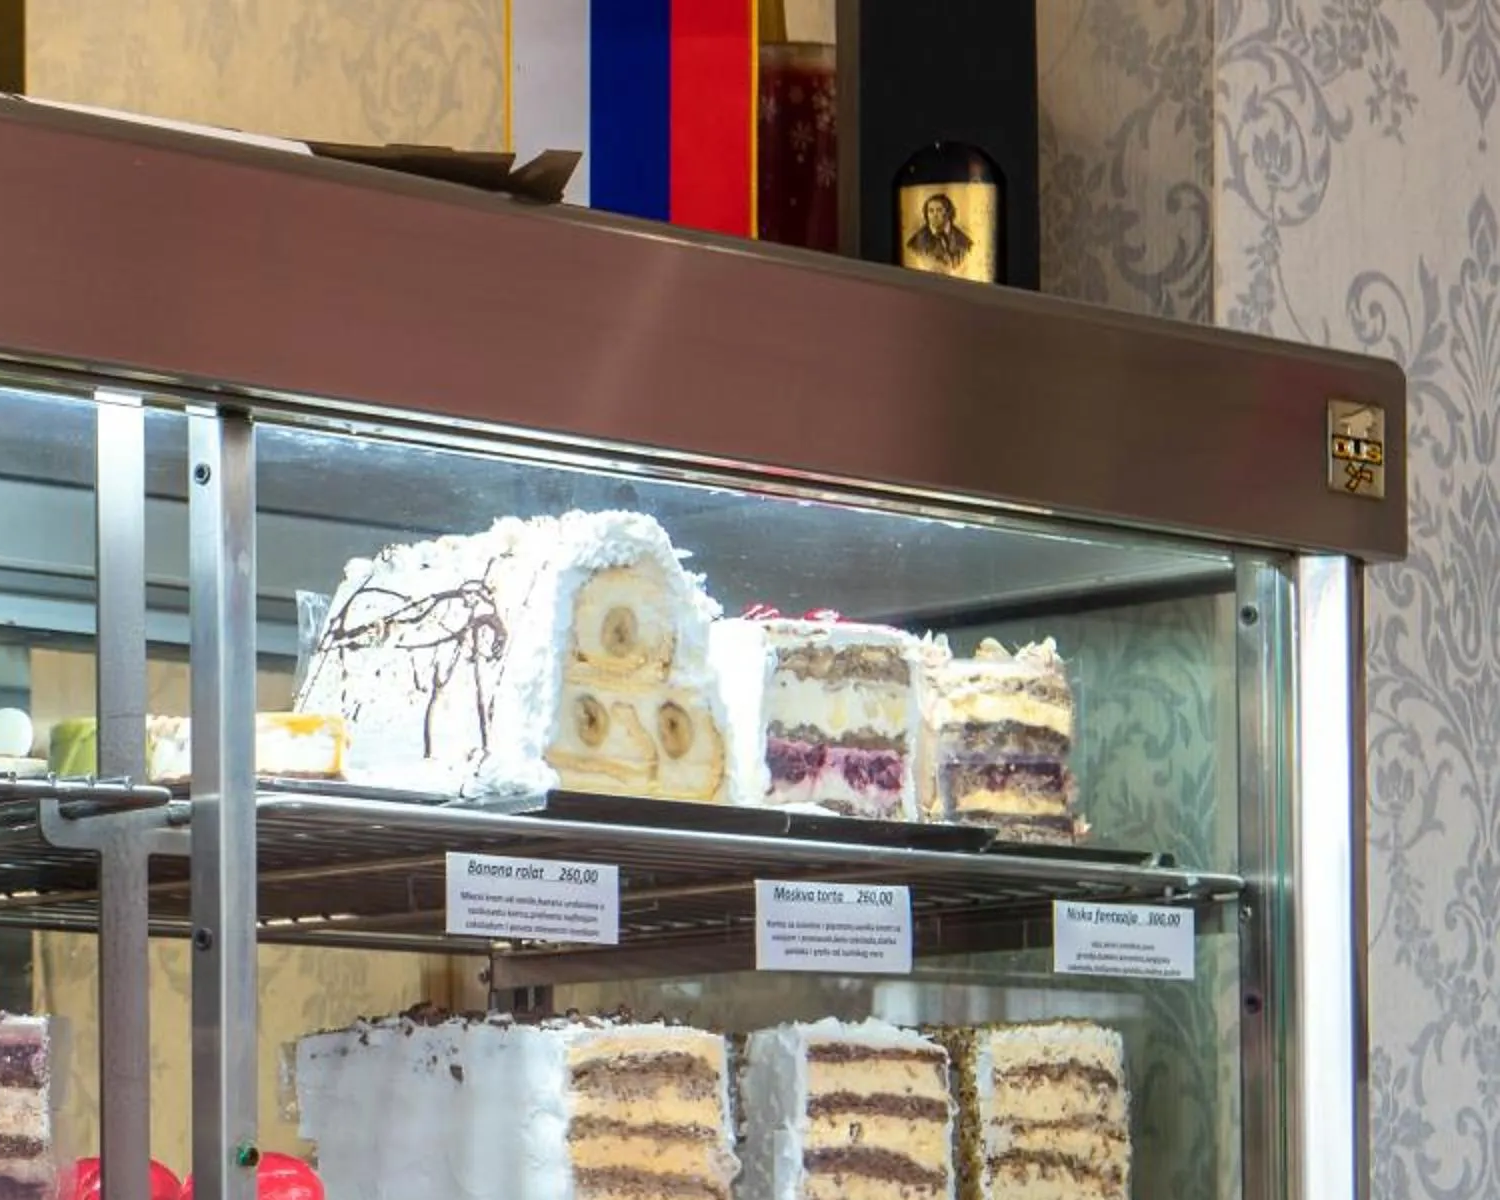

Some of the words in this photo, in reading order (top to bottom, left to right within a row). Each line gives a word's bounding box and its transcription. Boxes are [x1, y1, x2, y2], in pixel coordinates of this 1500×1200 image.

[468, 860, 512, 876] Banana
[515, 863, 544, 880] rolat
[559, 868, 598, 884] 260,00
